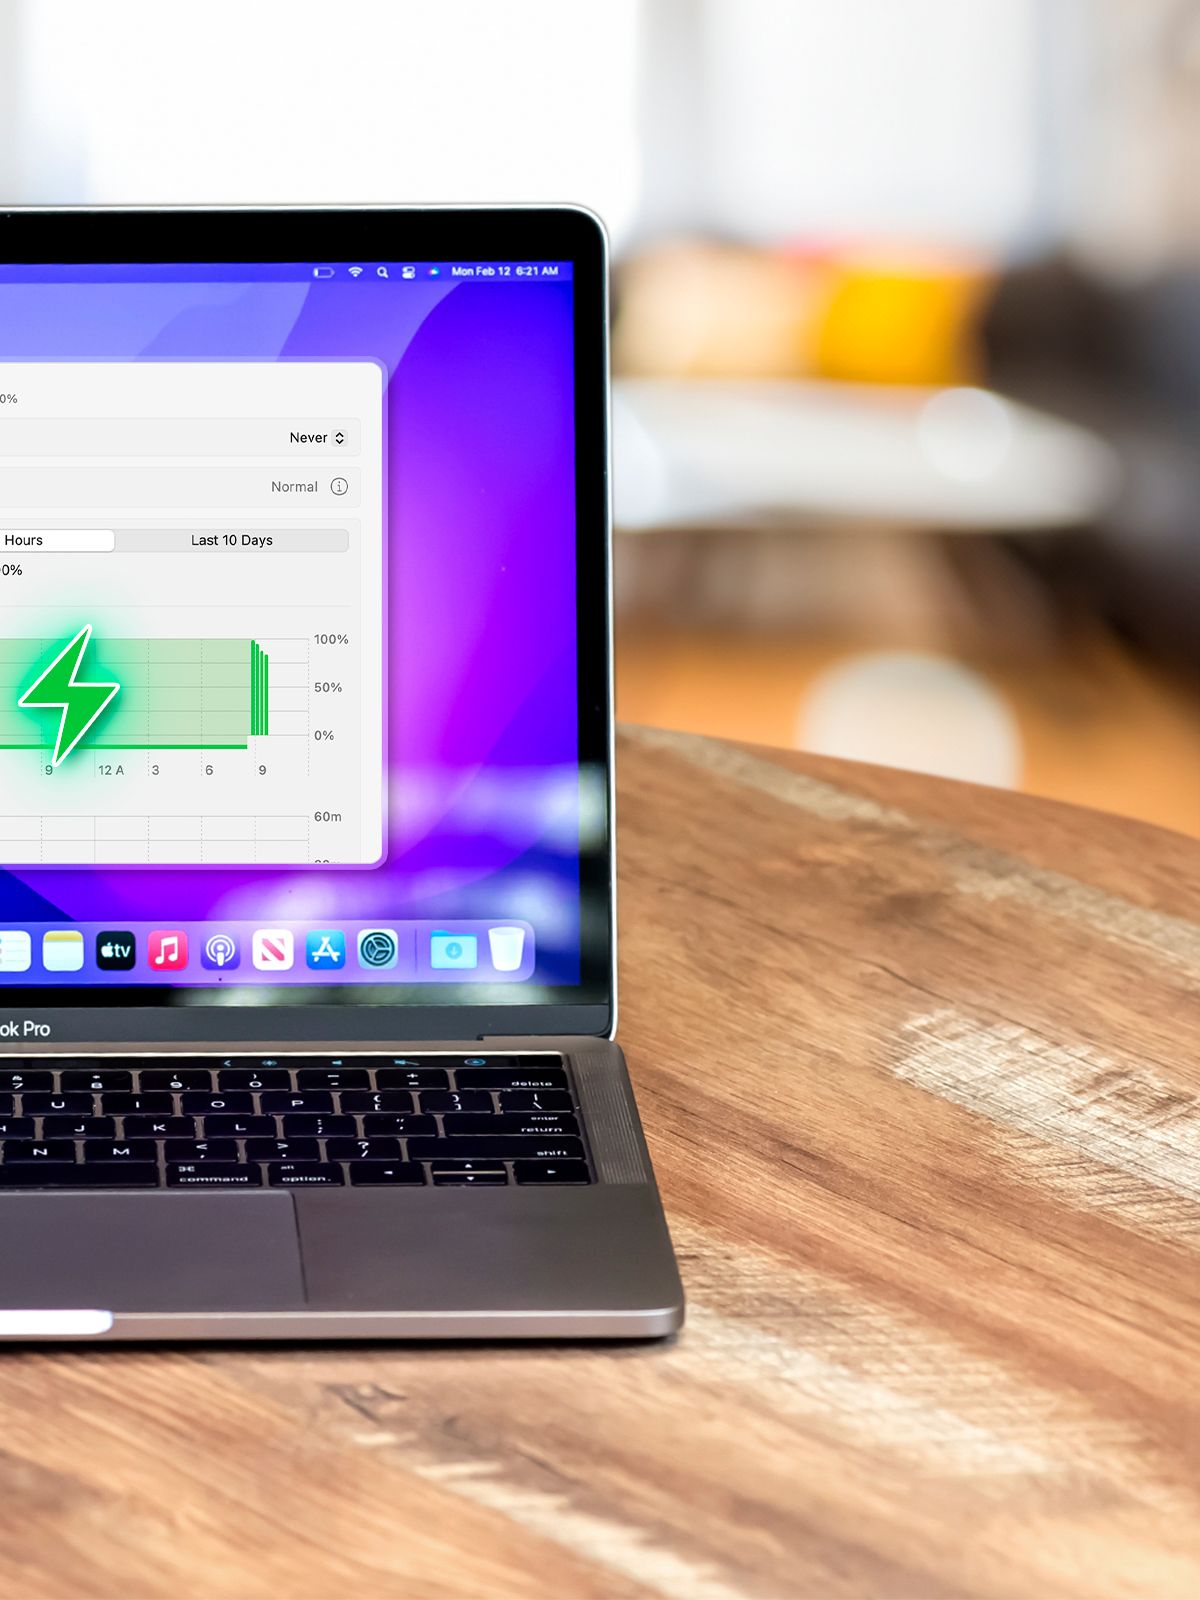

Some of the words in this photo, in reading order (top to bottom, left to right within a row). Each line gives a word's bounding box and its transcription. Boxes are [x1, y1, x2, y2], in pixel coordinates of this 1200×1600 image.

[451, 266, 475, 277] Mon
[475, 266, 496, 276] Feb
[497, 266, 511, 276] 12
[515, 265, 539, 276] 6:21
[541, 266, 559, 276] AM
[290, 431, 328, 444] Never
[271, 480, 318, 493] Normal
[4, 534, 43, 546] Hours
[191, 534, 219, 546] Last
[222, 534, 238, 546] 10
[241, 534, 273, 549] Days
[313, 633, 349, 645] 100%
[314, 681, 343, 693] 50%
[314, 730, 335, 741] 0%
[45, 764, 53, 776] 9
[98, 764, 112, 776] 12
[115, 764, 125, 776] A
[151, 764, 160, 776] 3
[205, 764, 214, 776] 6
[258, 764, 267, 776] 9
[314, 811, 342, 822] 60m
[23, 1020, 51, 1037] Pro
[50, 1101, 66, 1109] U
[210, 1100, 226, 1109] O
[291, 1099, 305, 1107] P
[74, 1124, 85, 1133] J
[152, 1123, 167, 1132] K
[234, 1123, 247, 1132] L
[32, 1147, 48, 1156] N
[112, 1147, 130, 1156] M
